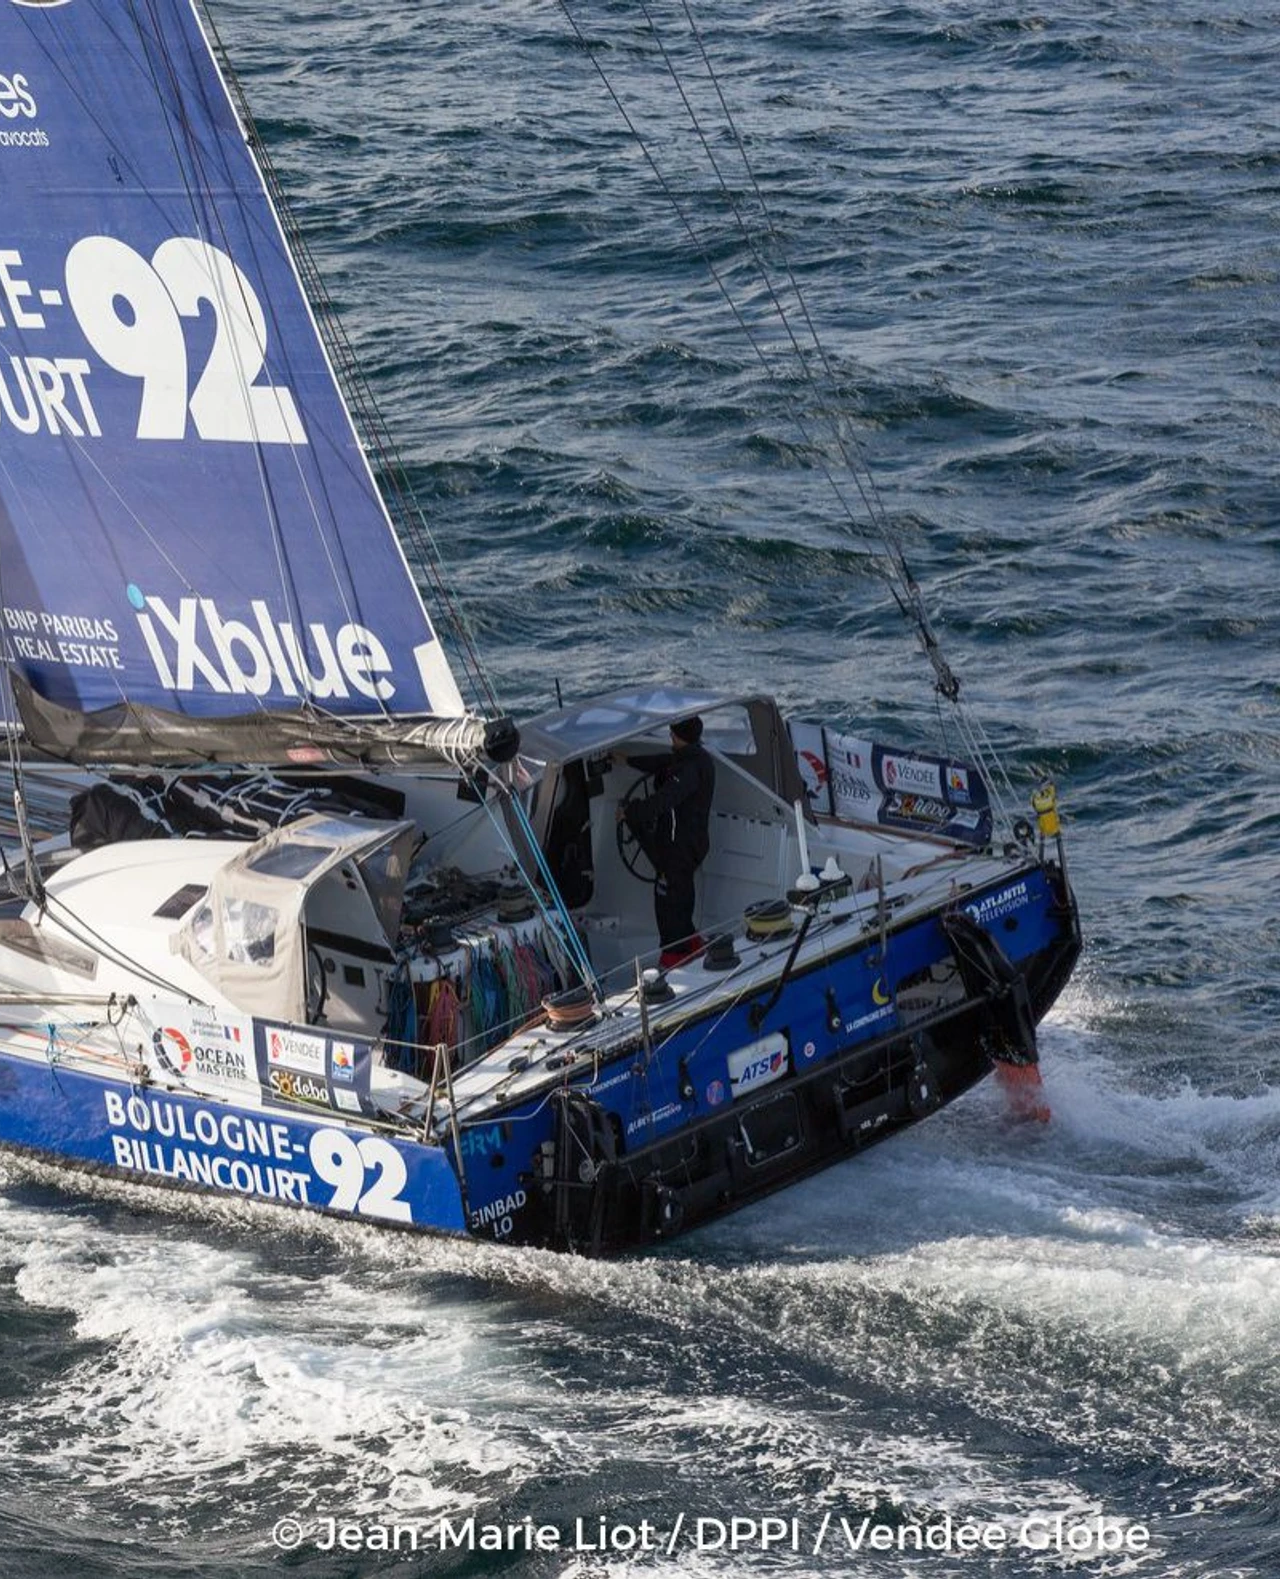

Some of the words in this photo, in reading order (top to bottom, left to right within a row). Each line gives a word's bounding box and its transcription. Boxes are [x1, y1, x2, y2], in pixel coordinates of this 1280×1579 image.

[64, 236, 308, 445] 92
[3, 607, 38, 633] BNP
[40, 612, 119, 642] PARIBAS
[127, 582, 397, 700] iXblue
[13, 635, 60, 663] REAL
[57, 641, 125, 670] ESTATE
[980, 881, 1027, 912] ATLANTIS
[194, 1046, 246, 1069] OCEAN
[195, 1061, 247, 1080] MASTERS
[740, 1057, 770, 1084] ATS
[270, 1071, 330, 1103] Sodebo
[104, 1090, 307, 1161] BOULOGNE-
[111, 1135, 311, 1203] BILLANCOURT
[308, 1128, 414, 1223] 92
[471, 1190, 526, 1229] SINBAD
